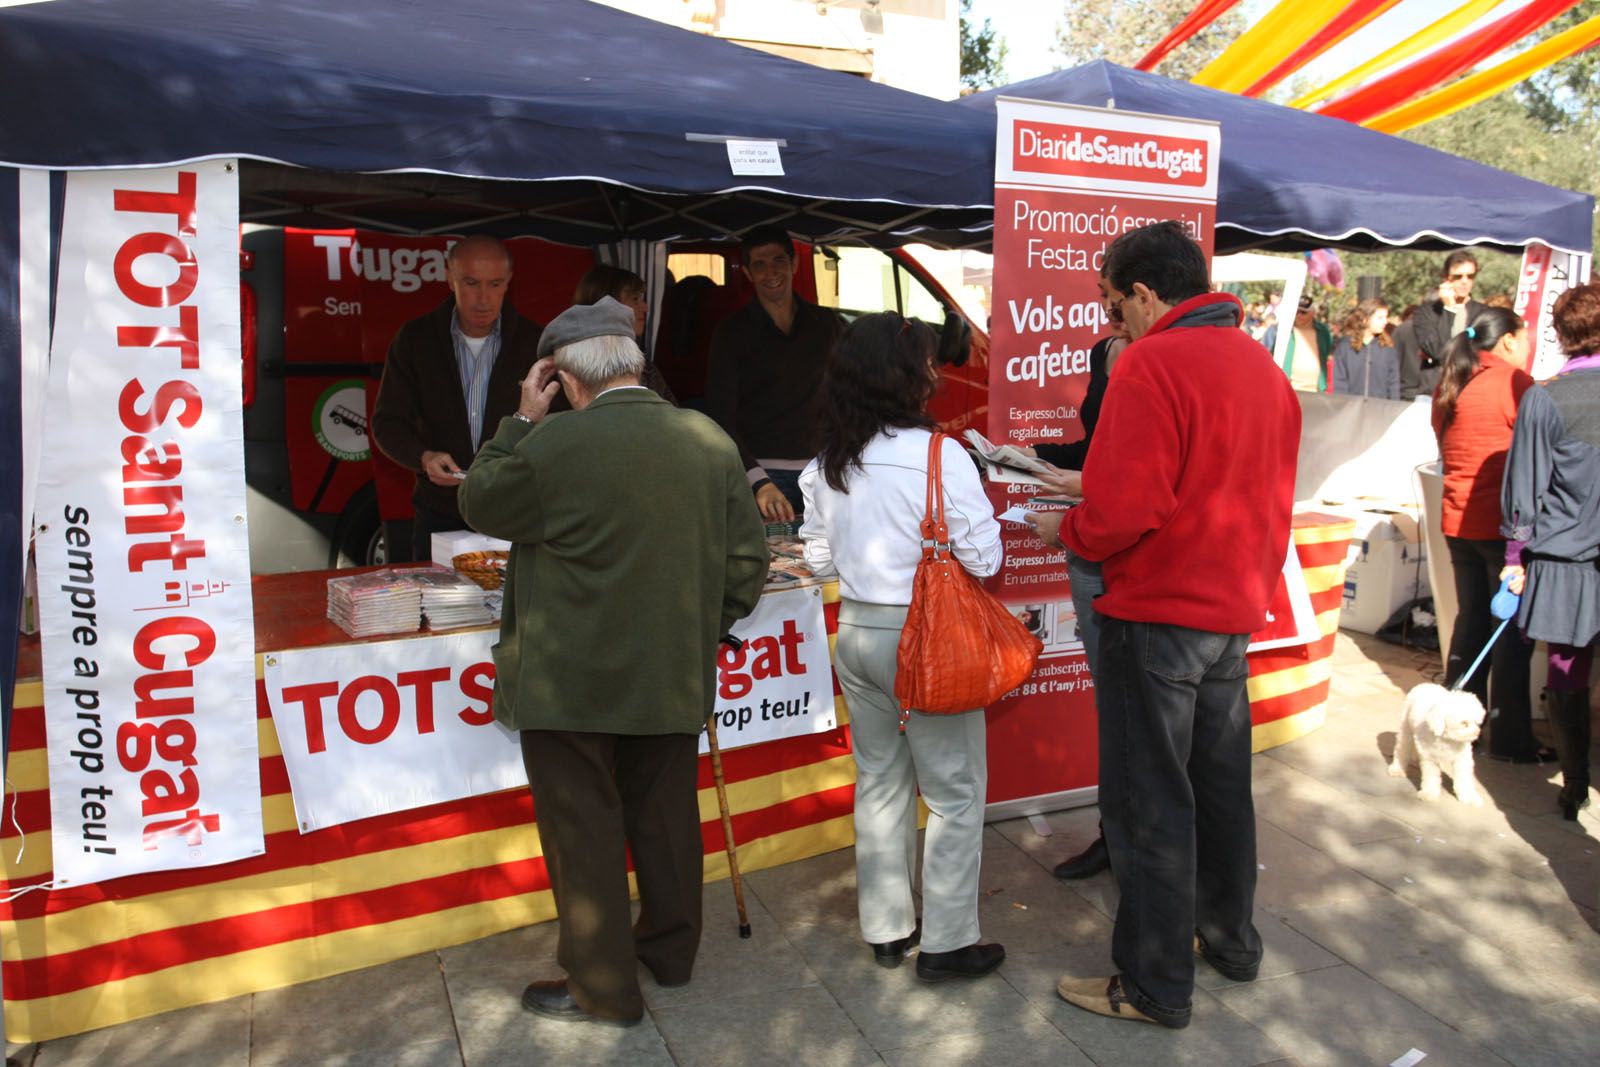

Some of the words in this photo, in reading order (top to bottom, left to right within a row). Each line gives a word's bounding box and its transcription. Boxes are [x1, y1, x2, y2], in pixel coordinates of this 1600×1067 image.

[1013, 199, 1119, 236] Promoció
[1122, 212, 1204, 242] esial
[113, 171, 200, 369] TOT
[1027, 239, 1088, 271] Festa
[1008, 294, 1064, 335] Vols
[1009, 426, 1039, 440] regala
[1040, 425, 1063, 437] dues
[1056, 406, 1077, 419] Club
[118, 377, 206, 573] Sant
[1007, 482, 1021, 494] de
[1005, 555, 1045, 569] Espresso
[1006, 539, 1022, 551] per
[61, 504, 98, 647] sempre
[1005, 573, 1019, 585] En
[1020, 574, 1038, 584] una
[73, 656, 99, 678] a
[716, 620, 807, 700] gat
[458, 662, 497, 726] S
[1022, 683, 1038, 696] 88
[1039, 681, 1048, 693] €
[1076, 677, 1081, 689] i
[66, 688, 104, 774] prop
[714, 704, 752, 731] rop
[760, 691, 811, 721] teu!
[116, 615, 220, 851] Cugat
[81, 785, 117, 855] teu!
